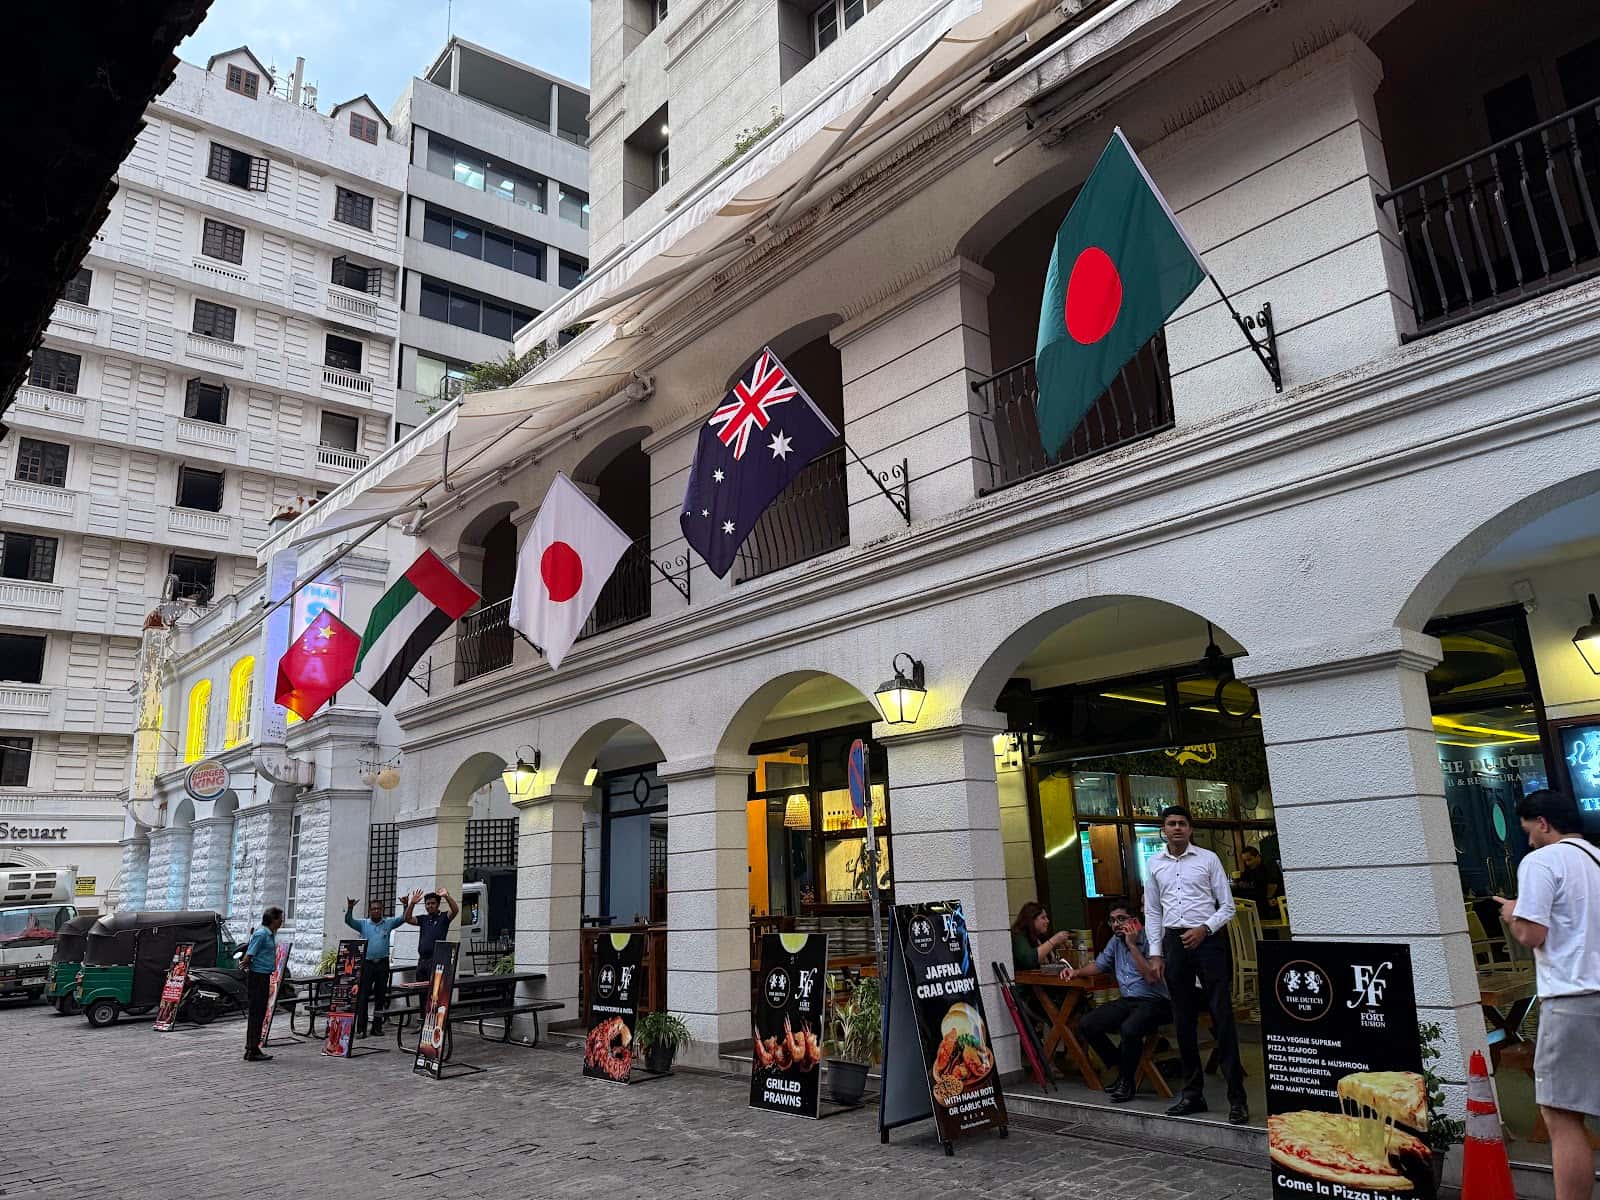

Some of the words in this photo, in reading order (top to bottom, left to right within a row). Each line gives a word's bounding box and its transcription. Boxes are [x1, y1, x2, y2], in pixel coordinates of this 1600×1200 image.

[1439, 761, 1464, 773] HE
[192, 769, 225, 780] BURGER
[192, 776, 225, 788] KING
[0, 822, 68, 839] Steuart
[925, 963, 962, 979] JAFFNA
[917, 983, 944, 999] CRAB
[945, 978, 975, 994] CURRY
[1361, 1013, 1385, 1021] FORT
[1267, 1034, 1286, 1042] PIZZA
[1286, 1036, 1310, 1044] VEGGIE
[1311, 1039, 1342, 1047] SUPREME
[1267, 1044, 1287, 1052] PIZZA
[1287, 1046, 1318, 1054] SEAFOOD
[1268, 1054, 1287, 1062] PIZZA
[1288, 1056, 1320, 1065] PEPERONI
[1327, 1061, 1369, 1070] MUSHROOM
[1268, 1064, 1288, 1072] PIZZA
[1289, 1065, 1332, 1076] MARGHERITA
[766, 1077, 801, 1093] GRILLED
[1269, 1074, 1289, 1082] PIZZA
[1289, 1075, 1320, 1085] MEXICAN
[944, 1095, 961, 1105] WITH
[962, 1090, 980, 1101] NAAN
[980, 1086, 994, 1096] ROTI
[1285, 1086, 1305, 1094] MANY
[1305, 1088, 1338, 1097] VARIETIES
[763, 1091, 801, 1107] PRAWNS
[949, 1107, 959, 1116] OR
[960, 1101, 981, 1112] GARLIC
[982, 1097, 995, 1107] RICE
[1277, 1174, 1313, 1192] Come
[1316, 1181, 1330, 1195] la
[1333, 1184, 1371, 1200] Pizza
